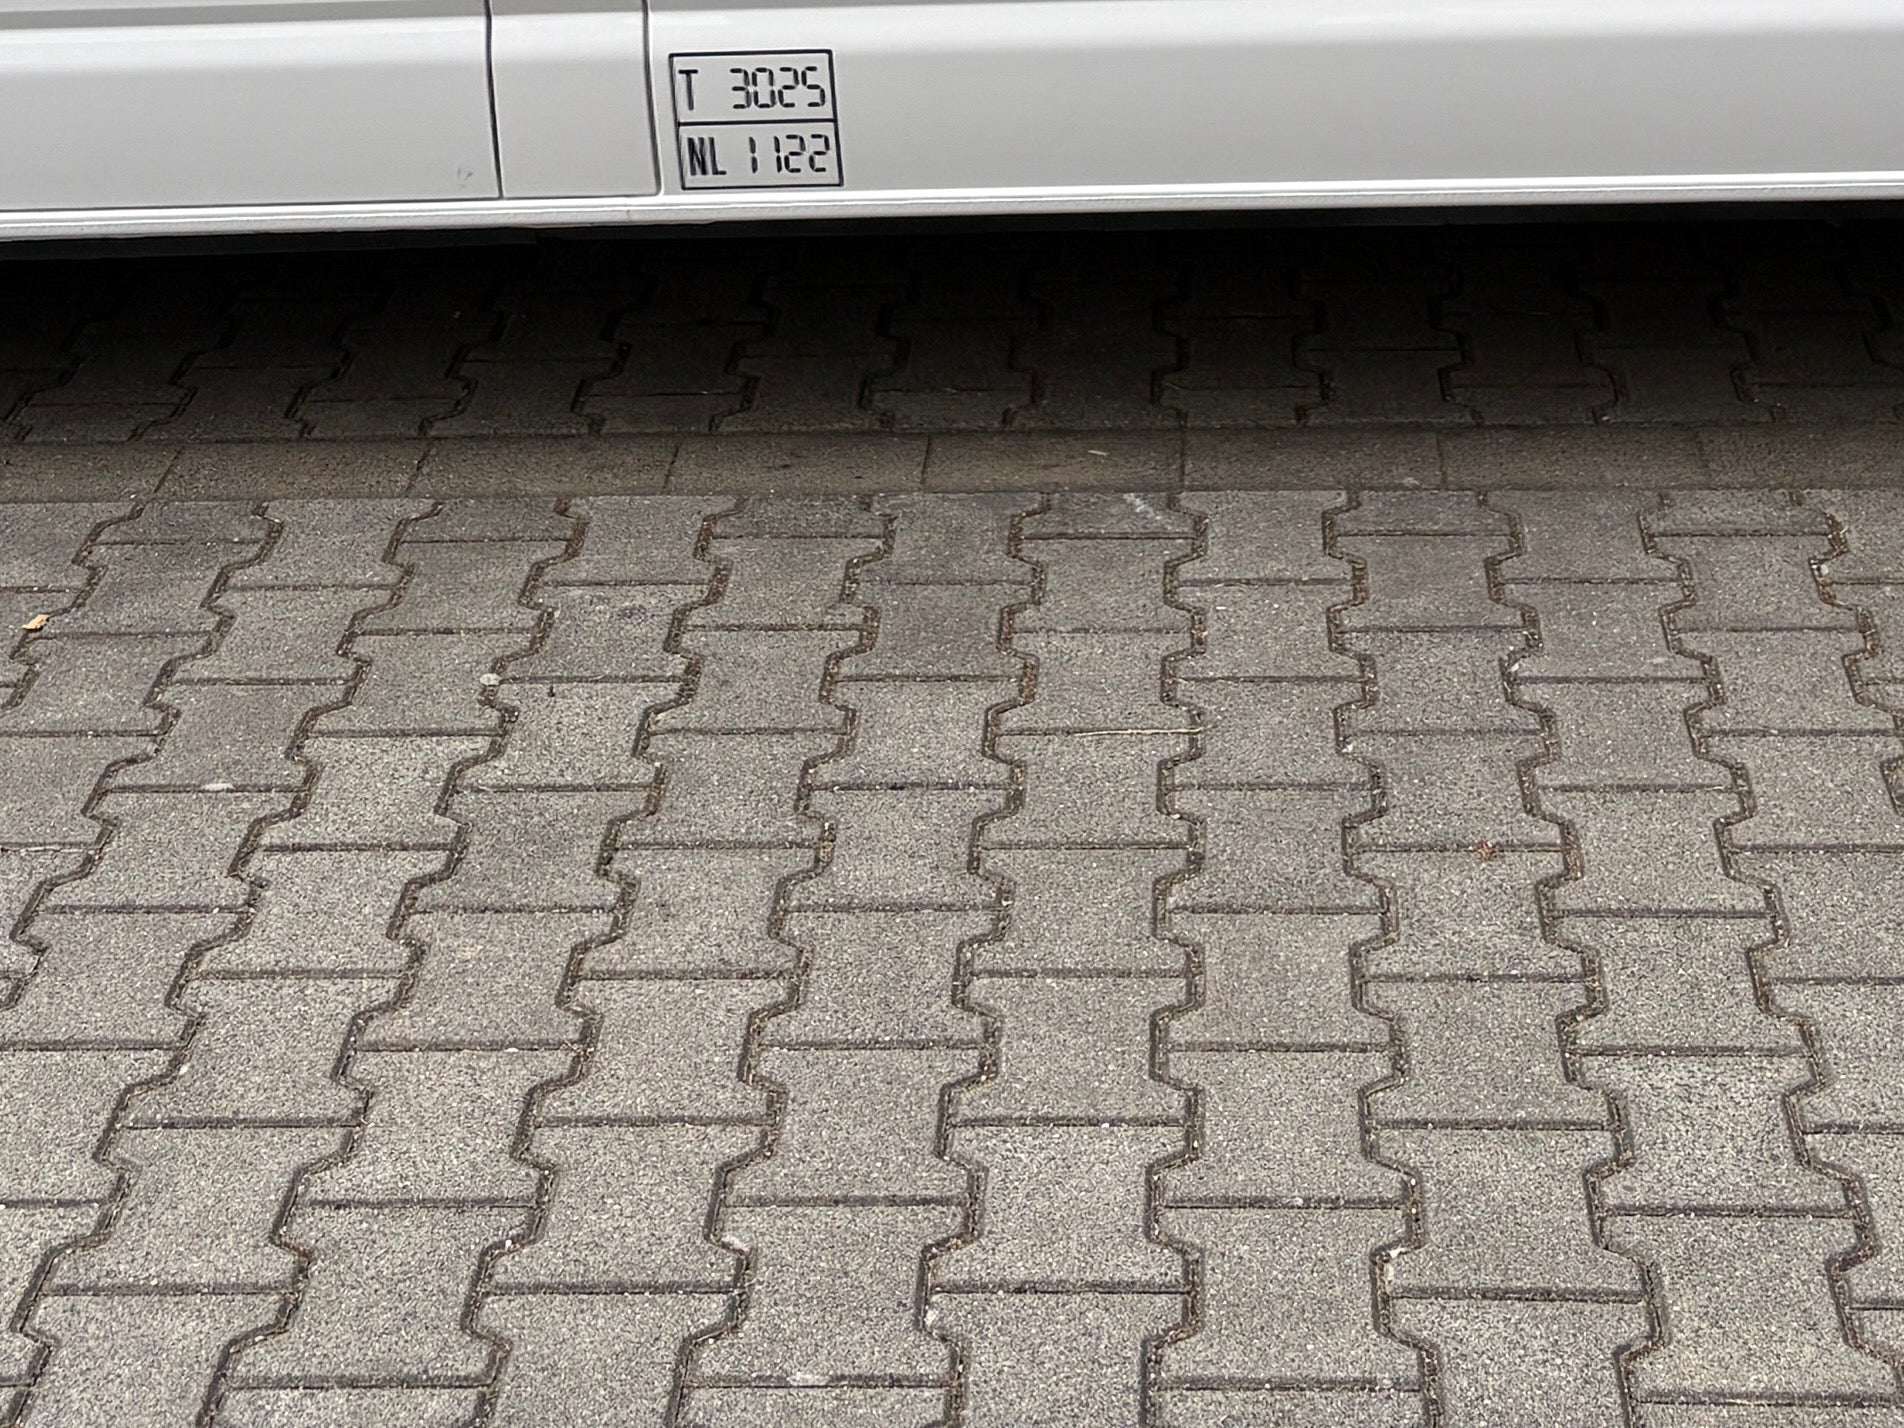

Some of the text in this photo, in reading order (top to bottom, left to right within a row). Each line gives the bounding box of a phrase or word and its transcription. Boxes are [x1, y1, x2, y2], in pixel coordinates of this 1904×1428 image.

[678, 66, 826, 111] T 3025
[687, 134, 830, 176] NL 1122
